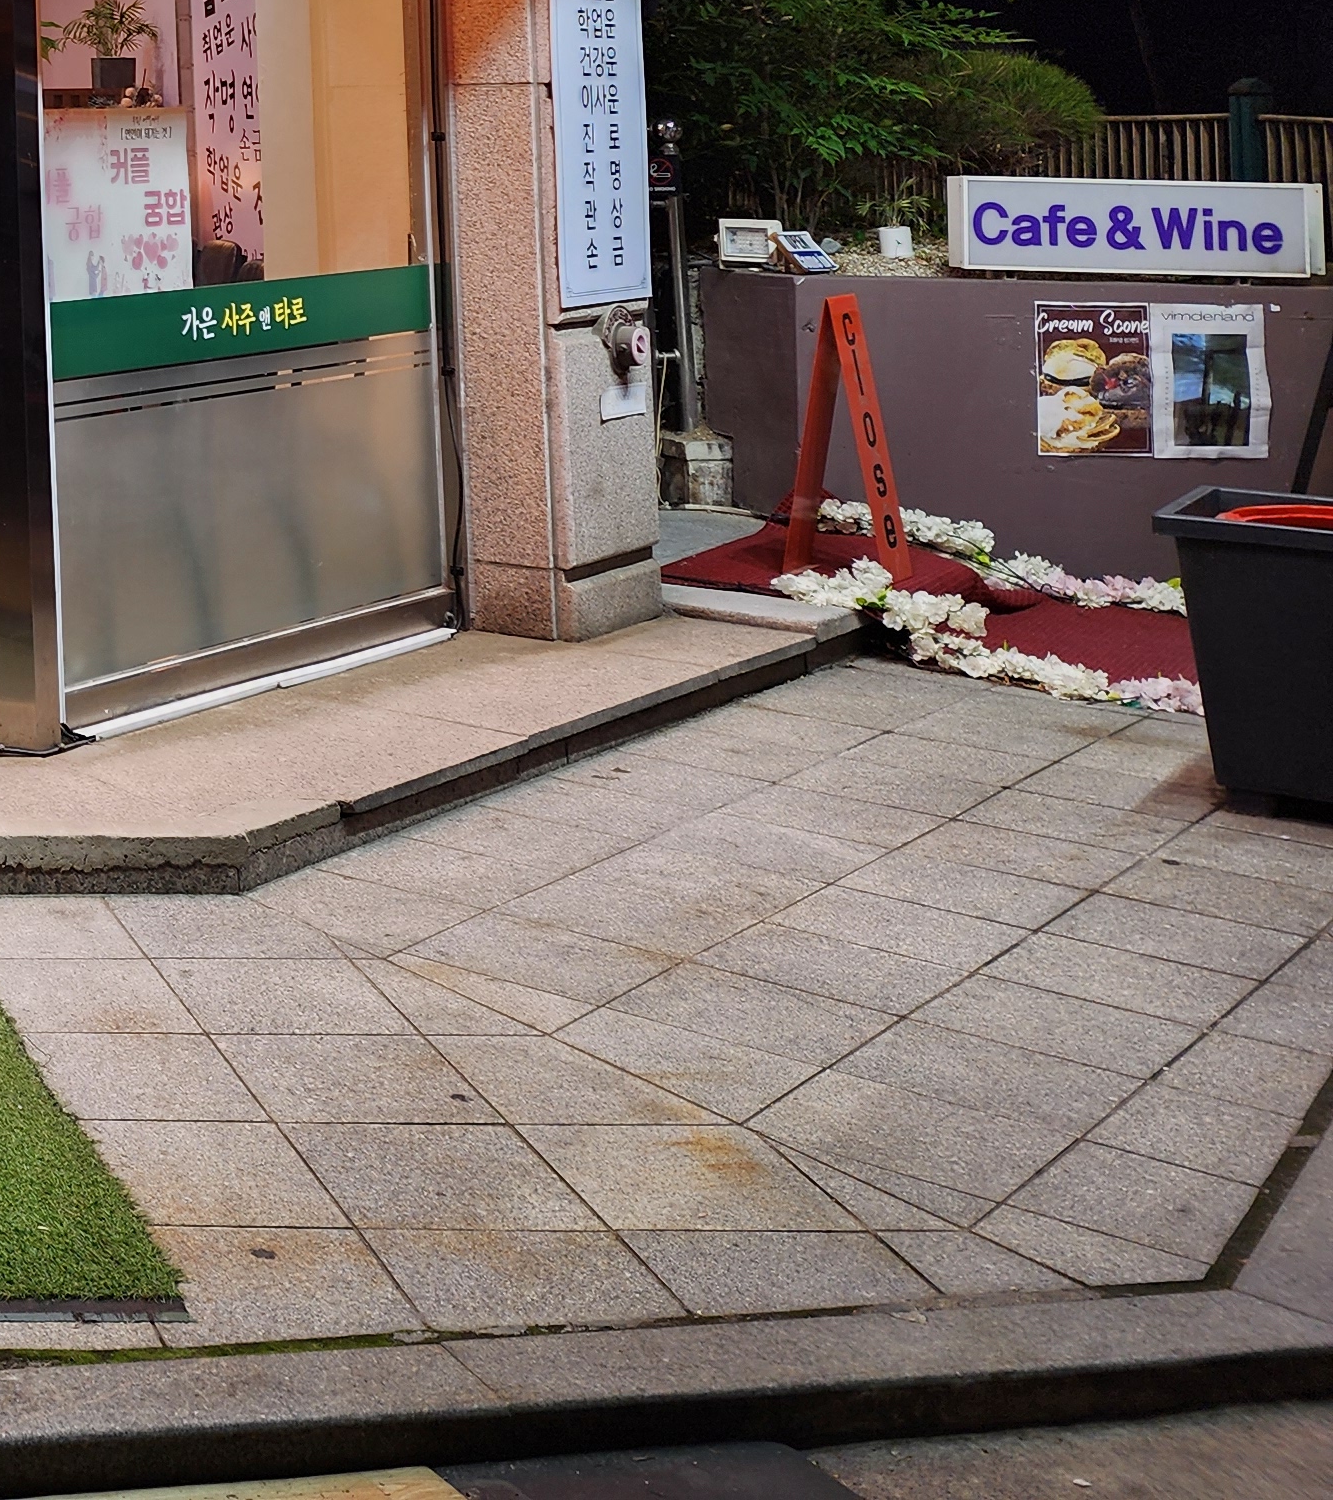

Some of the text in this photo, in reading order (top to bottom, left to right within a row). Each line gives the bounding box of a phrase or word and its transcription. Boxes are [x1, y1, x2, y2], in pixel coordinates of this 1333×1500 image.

[202, 13, 235, 63] 취업운
[577, 7, 616, 39] 학업운
[579, 46, 618, 78] 건강운
[203, 69, 237, 135] 작명
[581, 84, 620, 115] 이사운
[582, 123, 621, 153] 진로
[110, 147, 151, 185] 커플
[206, 145, 244, 203] 학업운
[583, 160, 622, 192] 작명
[143, 188, 188, 228] 궁합
[211, 201, 234, 241] 관상
[584, 198, 623, 231] 관상
[586, 236, 625, 270] 손금
[181, 296, 308, 341] 가은 사주 앤 타로
[1036, 309, 1150, 335] Cream Scone
